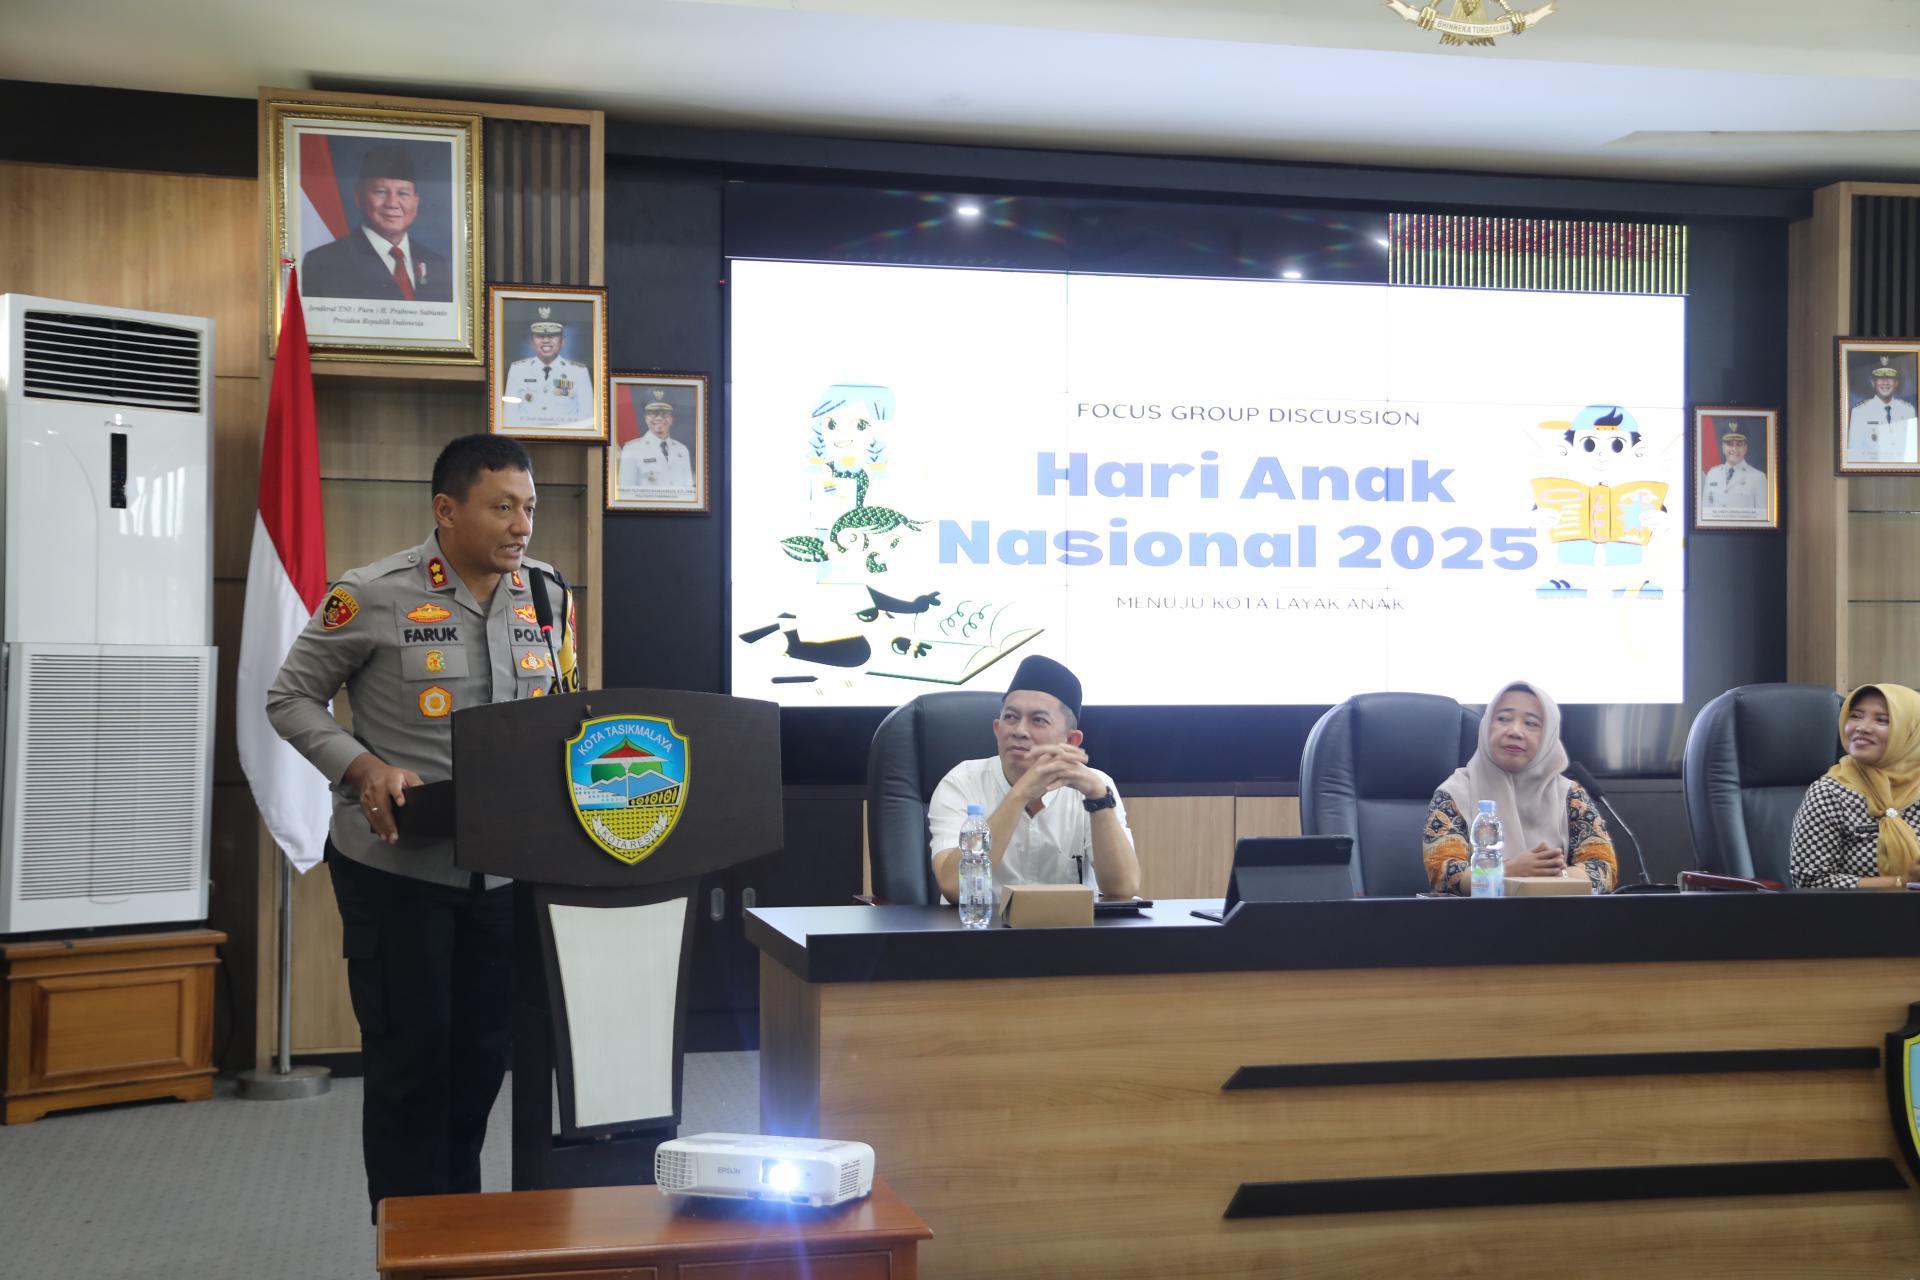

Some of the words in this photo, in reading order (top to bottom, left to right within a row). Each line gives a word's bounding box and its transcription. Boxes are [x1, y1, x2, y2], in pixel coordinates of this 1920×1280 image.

[1077, 403, 1162, 420] FOCUS
[1171, 405, 1260, 422] GROUP
[1269, 407, 1420, 426] DISCUSSION
[1037, 450, 1219, 499] Hari
[1239, 456, 1456, 502] Anak
[938, 517, 1317, 568] Nasional
[1337, 524, 1538, 570] 2025
[1117, 596, 1204, 610] MENUJU
[1213, 596, 1268, 610] KOTA
[1276, 597, 1340, 610] LAYAK
[1347, 598, 1404, 610] ANAK
[403, 626, 458, 643] FARUK
[577, 731, 606, 756] KOTA
[604, 724, 673, 753] TASIKMALAYA
[602, 829, 628, 849] KOTA
